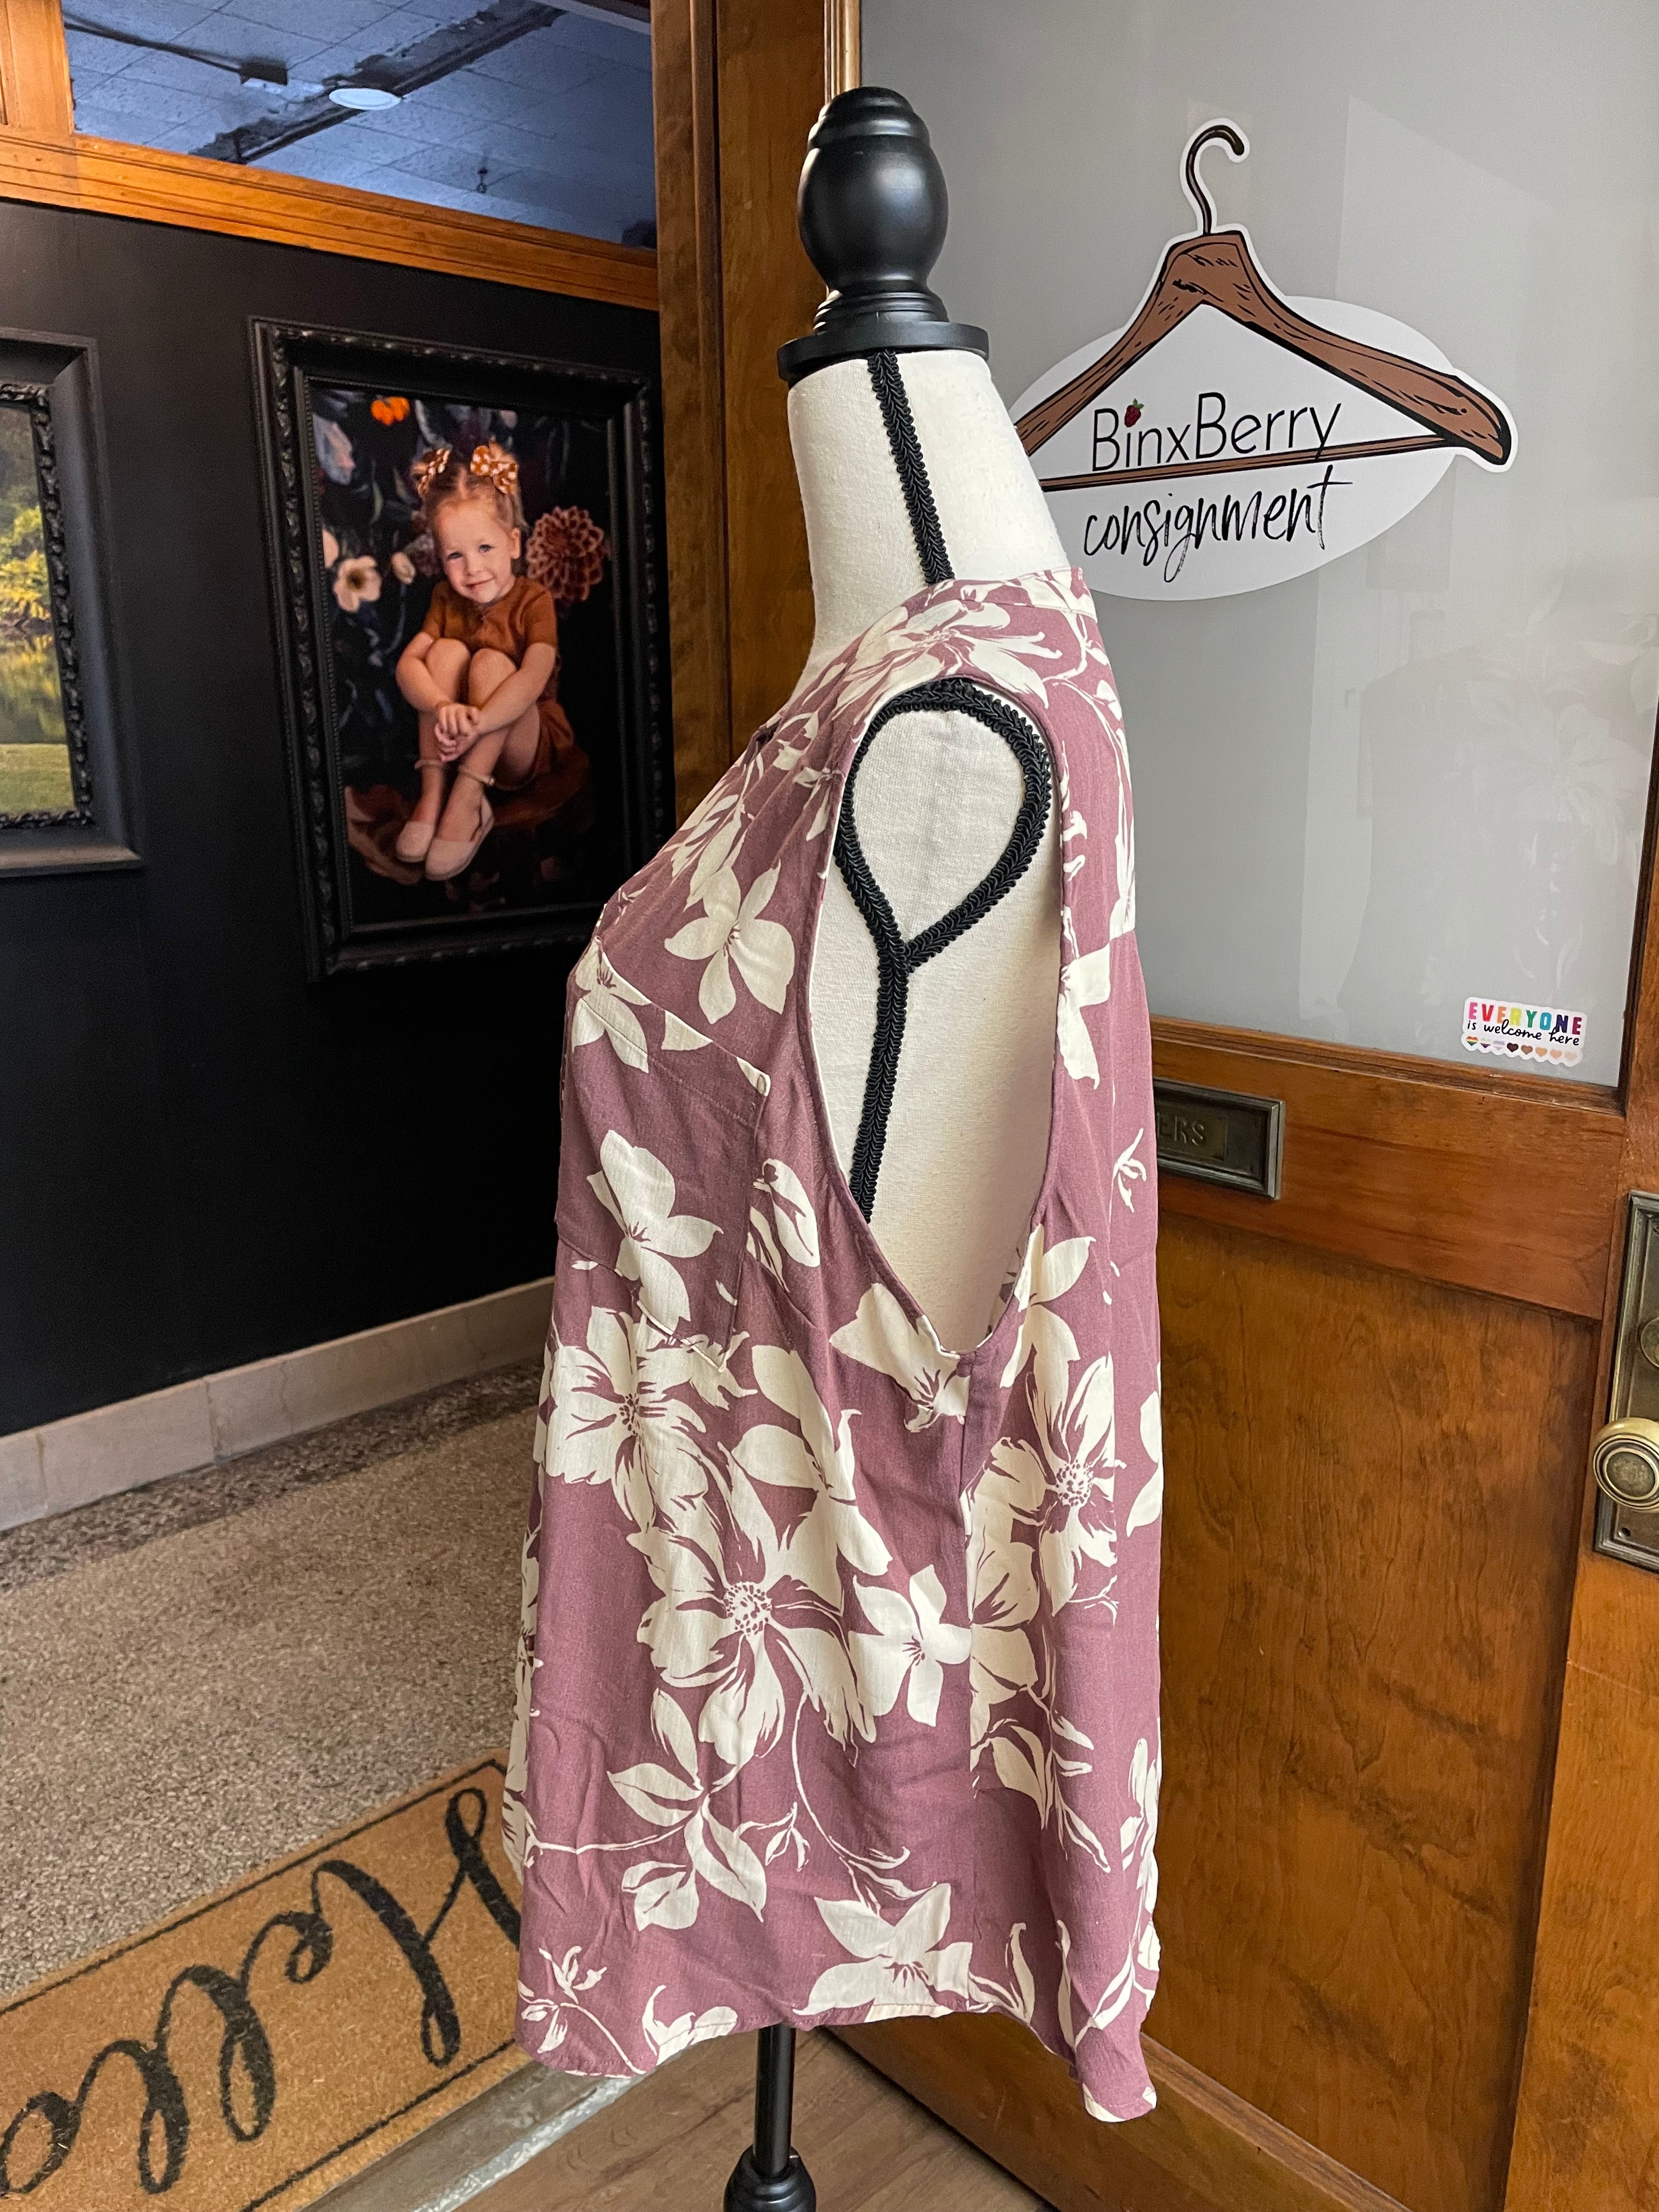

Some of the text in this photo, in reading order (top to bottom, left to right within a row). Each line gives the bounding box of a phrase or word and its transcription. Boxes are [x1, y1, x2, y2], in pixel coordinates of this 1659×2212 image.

[1092, 392, 1342, 472] BinxBerry
[1084, 465, 1353, 583] consignment
[1467, 1019, 1580, 1046] is welcome here
[1468, 1002, 1582, 1035] EVERYONE
[0, 1787, 520, 2194] Hello
